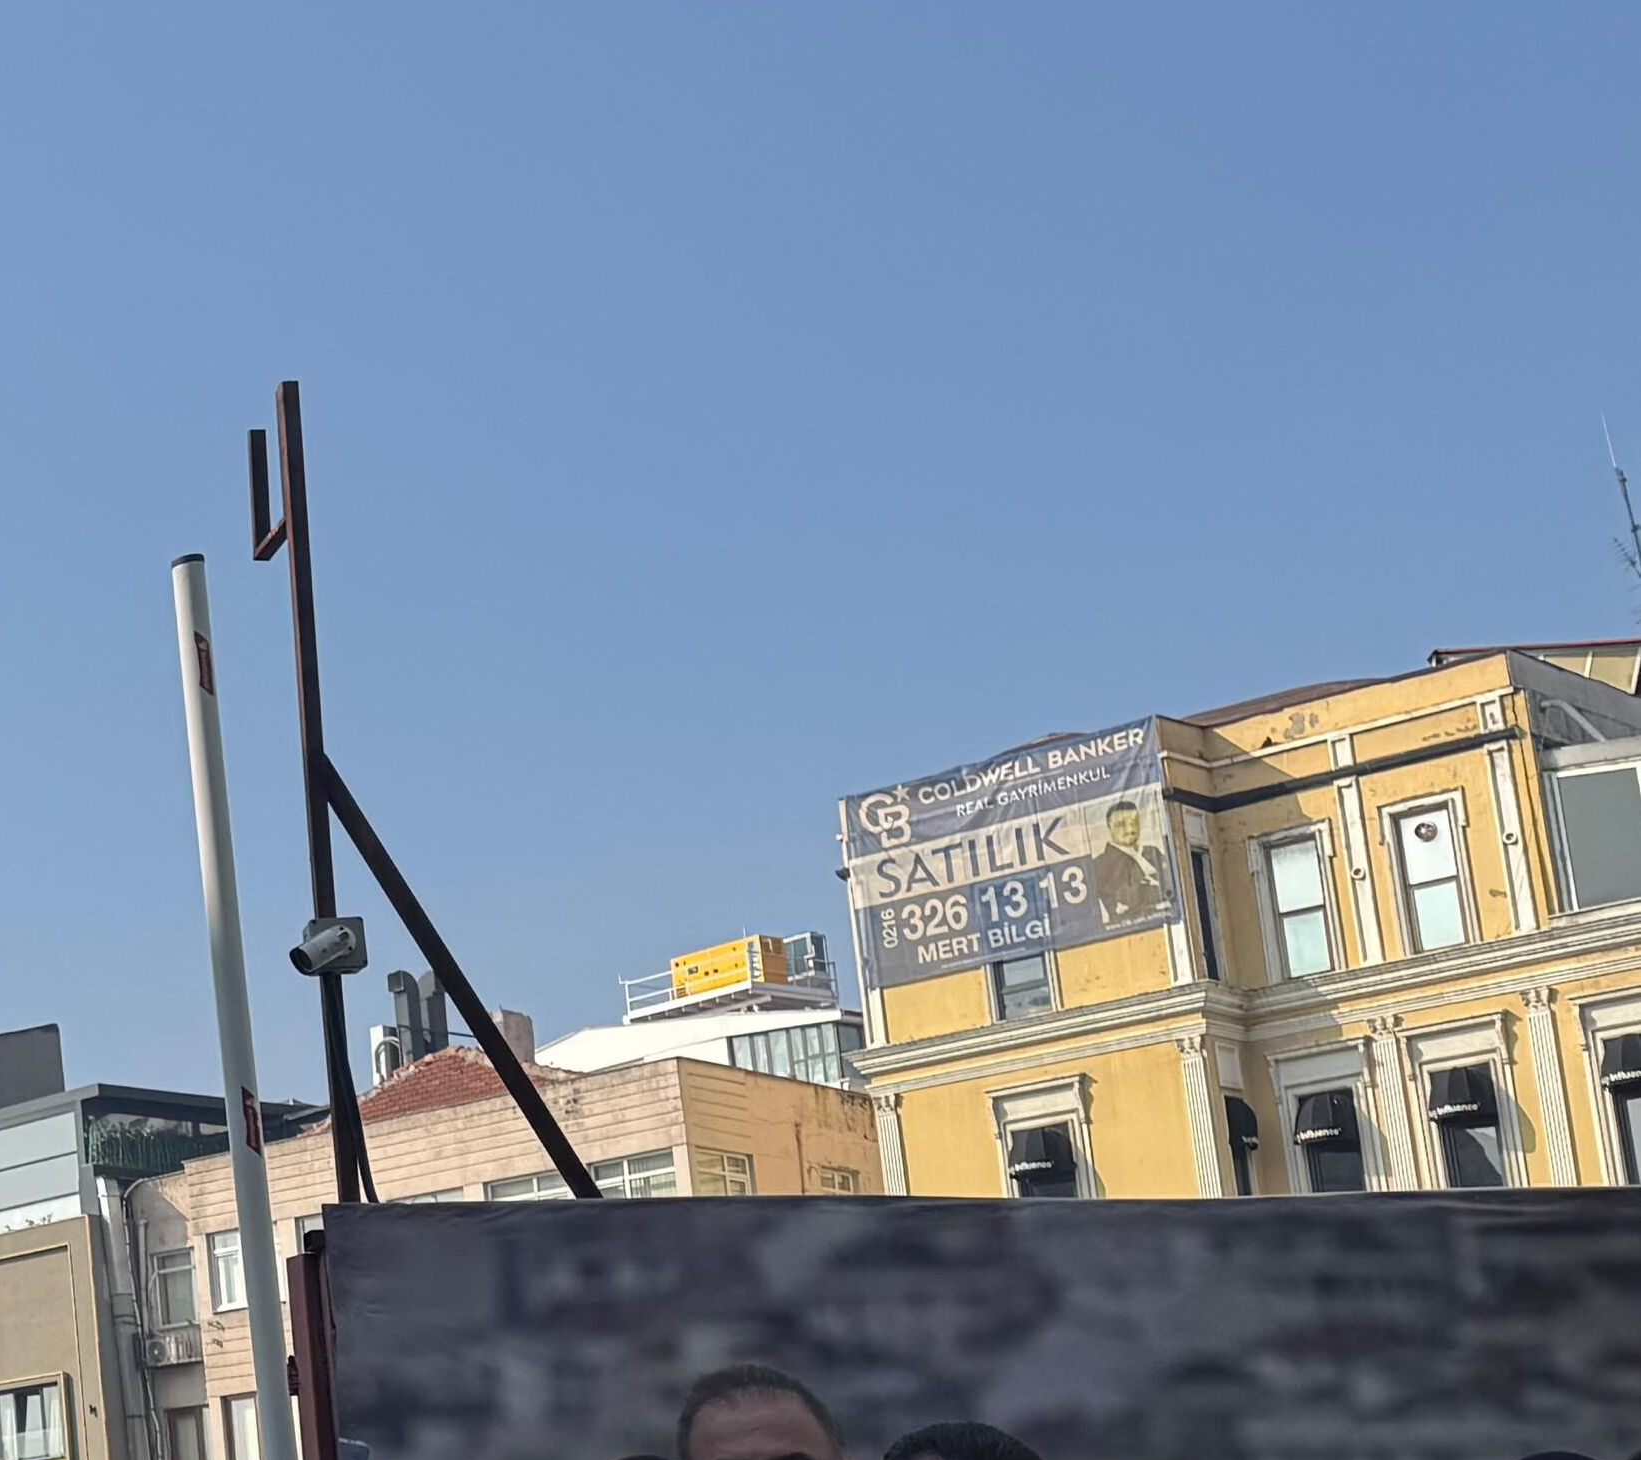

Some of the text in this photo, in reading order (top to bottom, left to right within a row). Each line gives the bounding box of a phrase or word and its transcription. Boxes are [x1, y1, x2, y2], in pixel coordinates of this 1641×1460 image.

[918, 727, 1144, 805] COLDWELL BANKER
[956, 797, 994, 817] REAL
[876, 816, 1071, 899] SATILIK
[880, 866, 1088, 948] 0216 326 13 13
[917, 932, 981, 964] MERT
[987, 913, 1052, 949] BİLGİ
